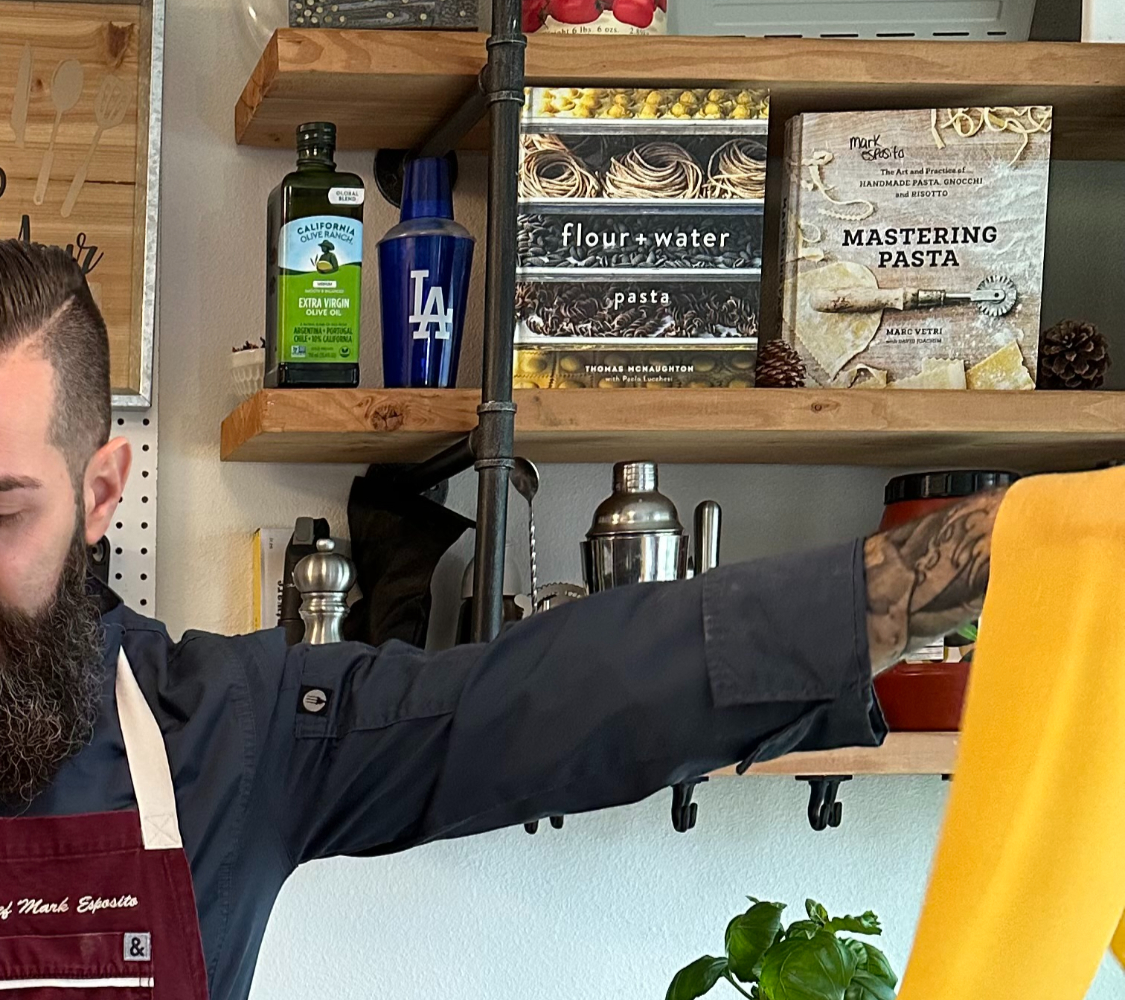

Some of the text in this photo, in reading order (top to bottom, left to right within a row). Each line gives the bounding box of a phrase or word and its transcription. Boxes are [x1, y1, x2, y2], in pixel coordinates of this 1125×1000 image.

[881, 168, 895, 176] The
[896, 168, 908, 176] Art
[926, 167, 956, 175] Practice
[957, 166, 967, 174] of
[860, 180, 911, 188] HANDMADE
[944, 177, 983, 186] GNOCCHI
[912, 190, 949, 198] RISOTTO
[297, 222, 355, 237] CALIFORNIA
[561, 223, 629, 248] flour
[654, 228, 730, 248] water
[300, 231, 323, 243] OLIVE
[842, 226, 997, 247] MASTERING
[878, 250, 960, 268] PASTA
[298, 297, 350, 309] EXTRA VIRGIN
[409, 270, 453, 339] LA
[614, 289, 670, 310] pasta
[305, 308, 342, 316] OLIVE OIL
[294, 327, 353, 335] ARGENTINA PORTUGAL
[886, 328, 913, 336] MARC
[323, 335, 353, 343] CALIFORNIA
[585, 365, 694, 373] THOMAS MCNAUGHTON
[17, 897, 70, 915] Mark
[76, 894, 139, 914] Esposito
